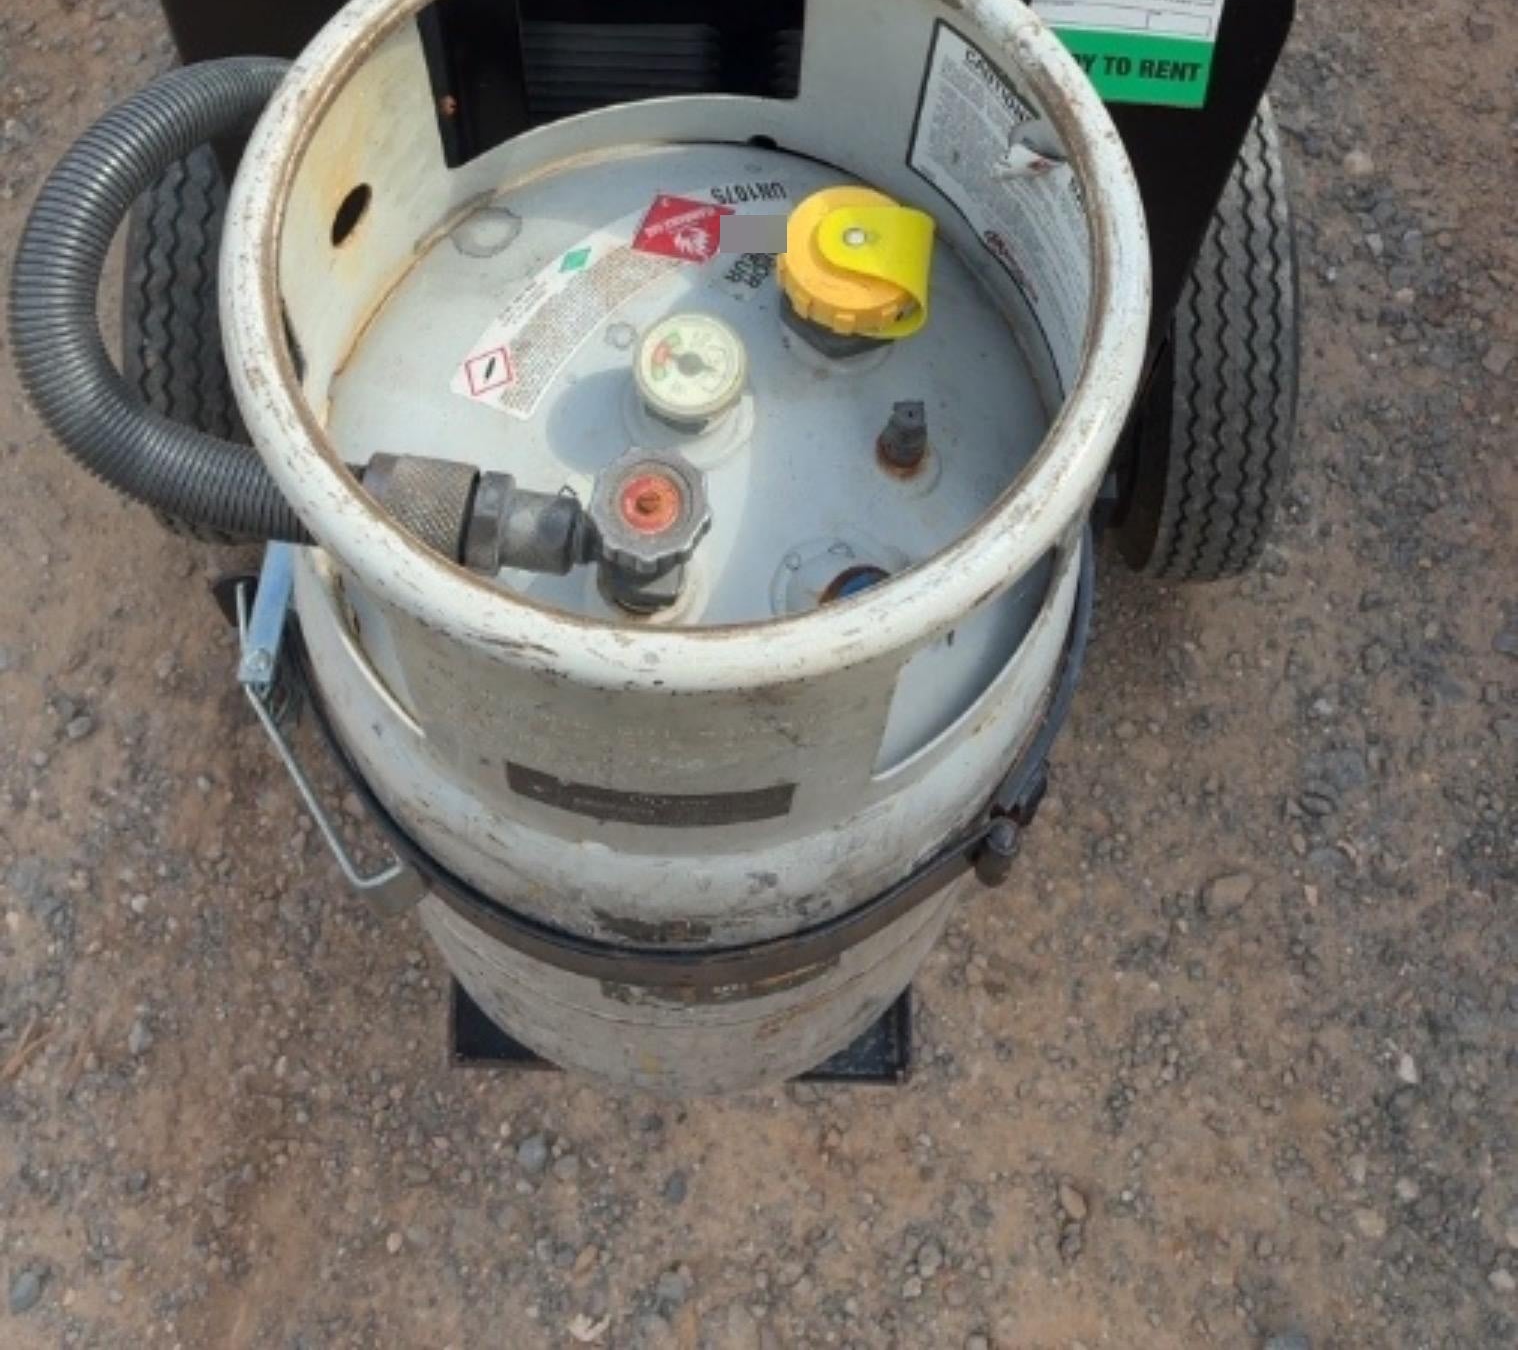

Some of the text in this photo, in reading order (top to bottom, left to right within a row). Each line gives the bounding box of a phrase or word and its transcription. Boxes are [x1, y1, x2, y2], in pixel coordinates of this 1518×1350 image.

[1103, 56, 1132, 76] TO
[1139, 58, 1203, 82] RENT
[710, 181, 787, 205] UN1075
